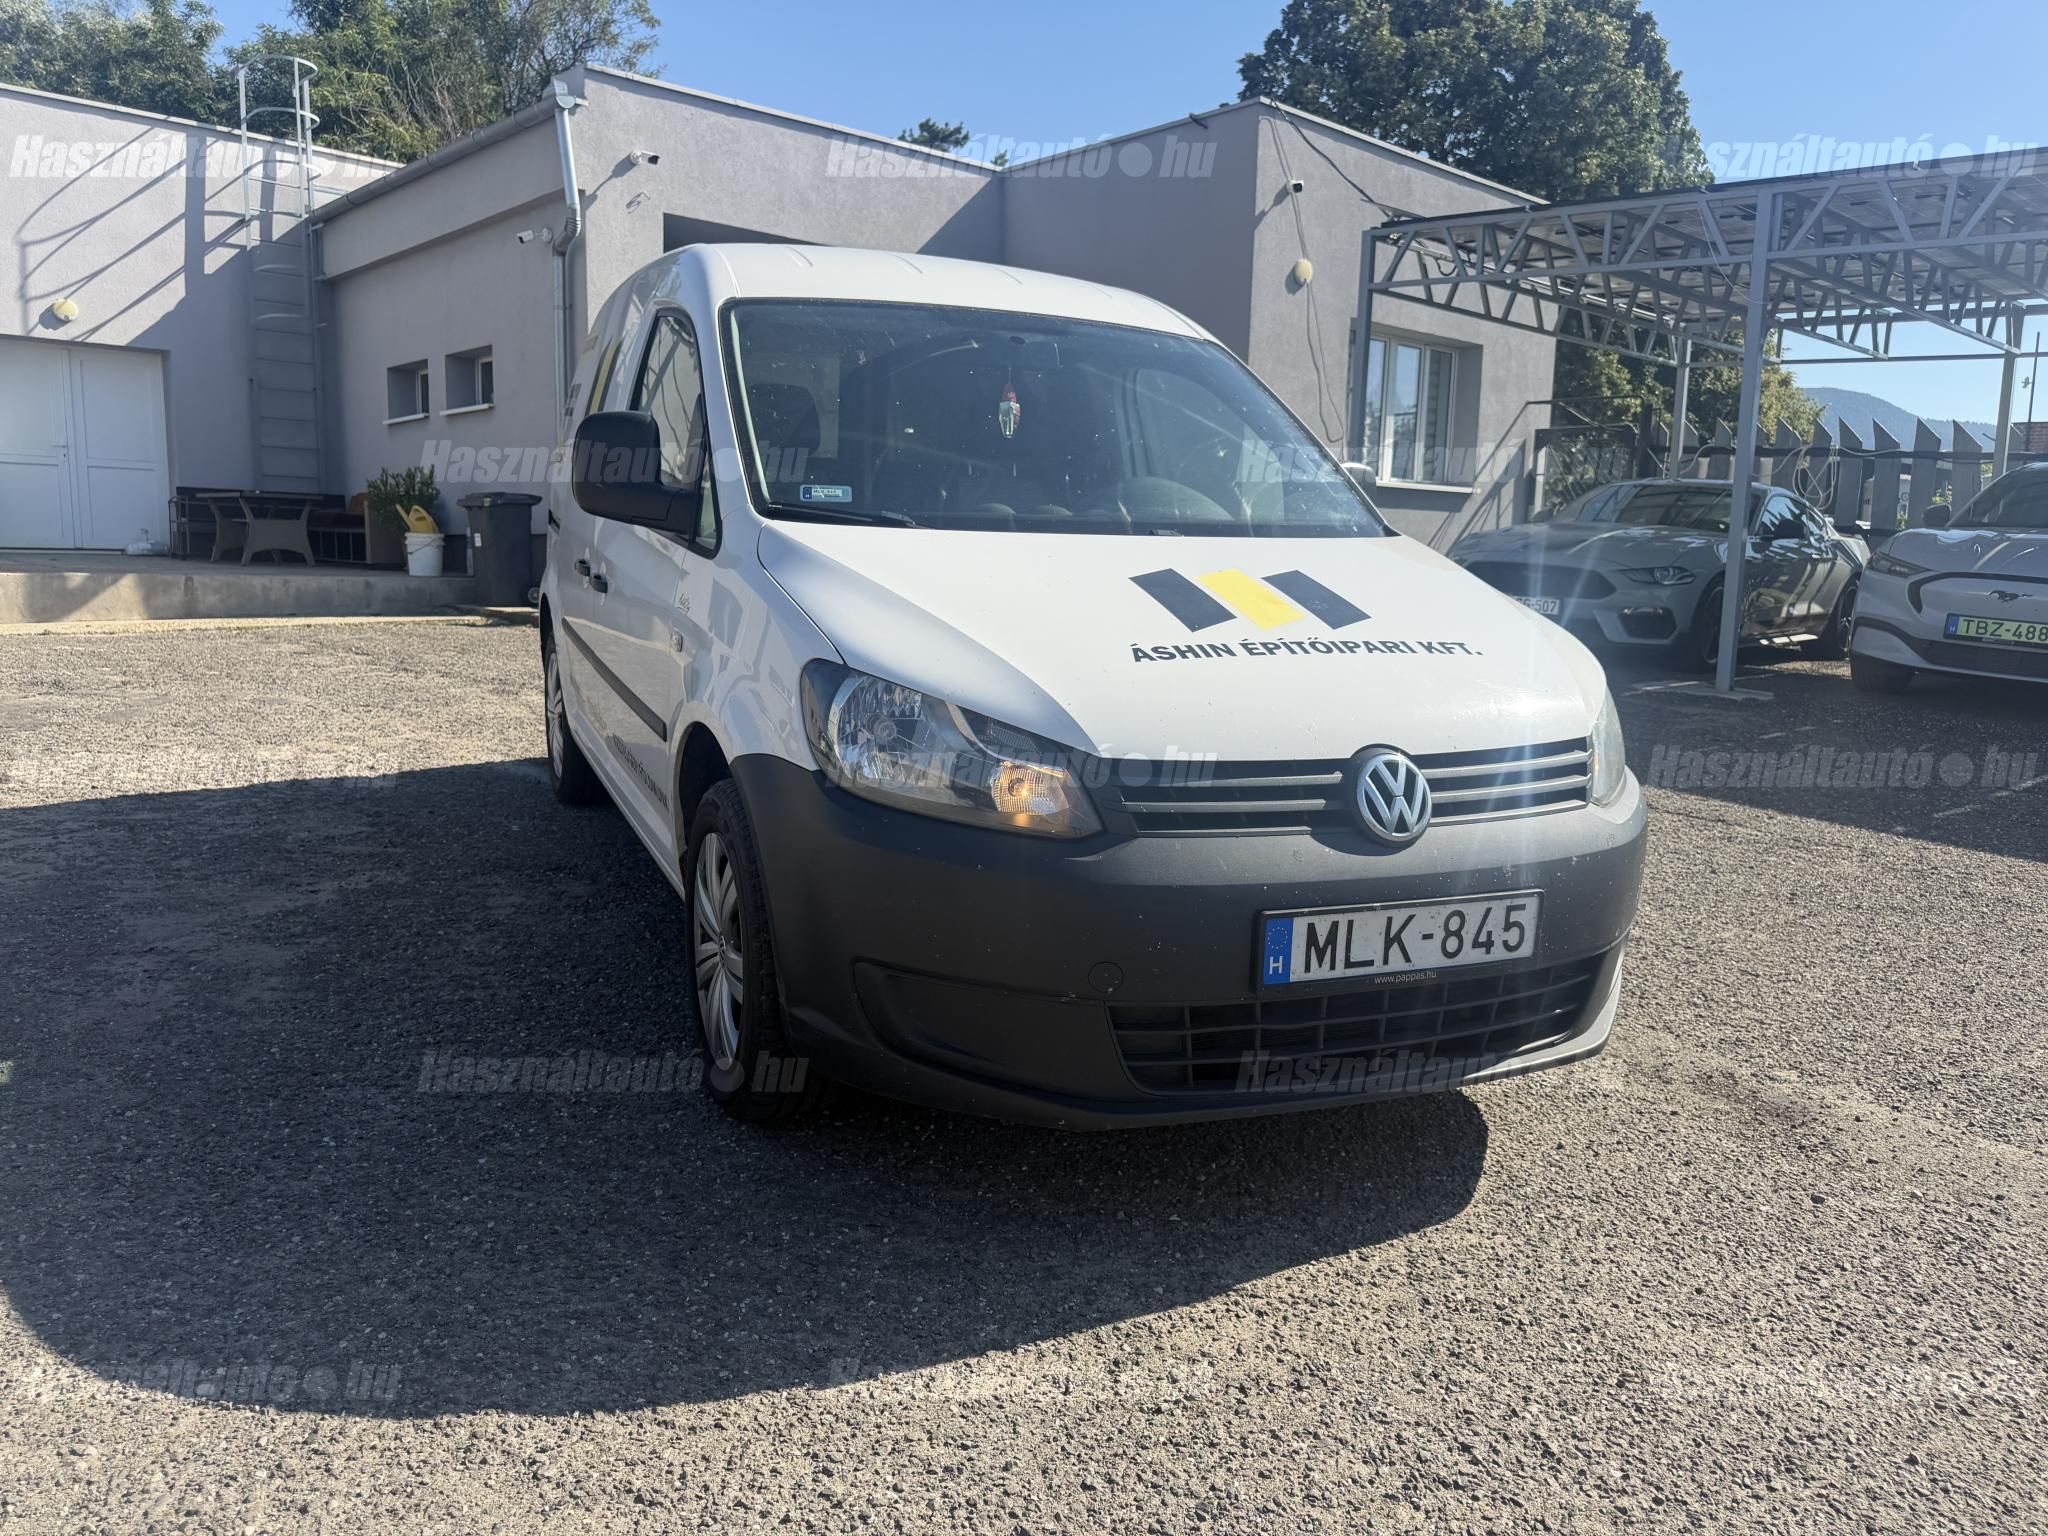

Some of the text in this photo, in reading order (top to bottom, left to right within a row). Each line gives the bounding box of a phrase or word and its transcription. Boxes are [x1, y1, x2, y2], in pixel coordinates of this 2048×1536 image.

[1963, 618, 2048, 642] TBZ-488
[1130, 636, 1484, 662] ÁSHIN ÉPÍTŐIPARI KFT.
[1304, 903, 1527, 974] MLK-845
[1269, 955, 1283, 976] H
[1374, 969, 1438, 985] www.pappas.hu
